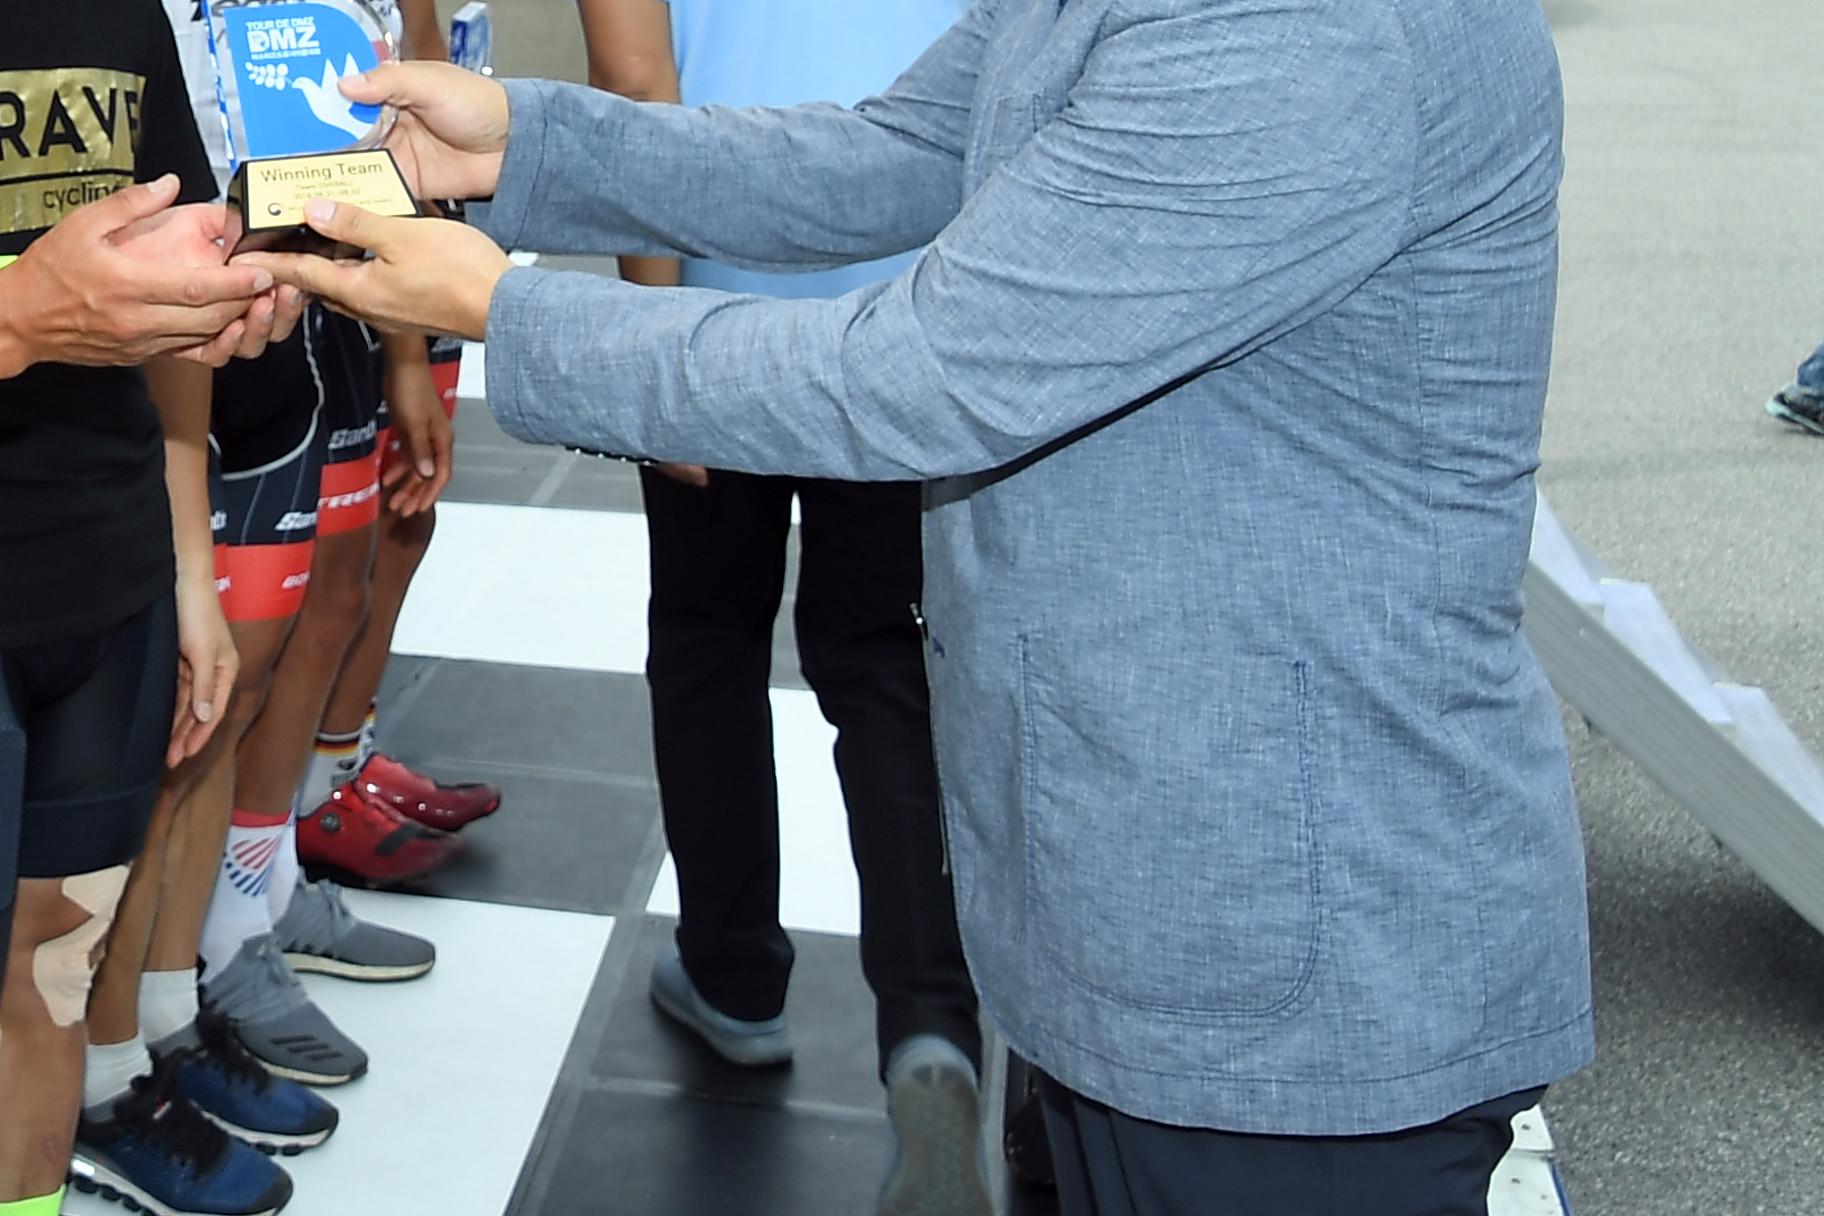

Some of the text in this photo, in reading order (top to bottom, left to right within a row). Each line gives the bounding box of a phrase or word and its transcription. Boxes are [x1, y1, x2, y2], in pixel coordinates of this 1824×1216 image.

[246, 20, 274, 32] TOUR
[246, 26, 320, 53] DMZ
[260, 162, 383, 182] Winning Team
[43, 181, 124, 210] cyclin
